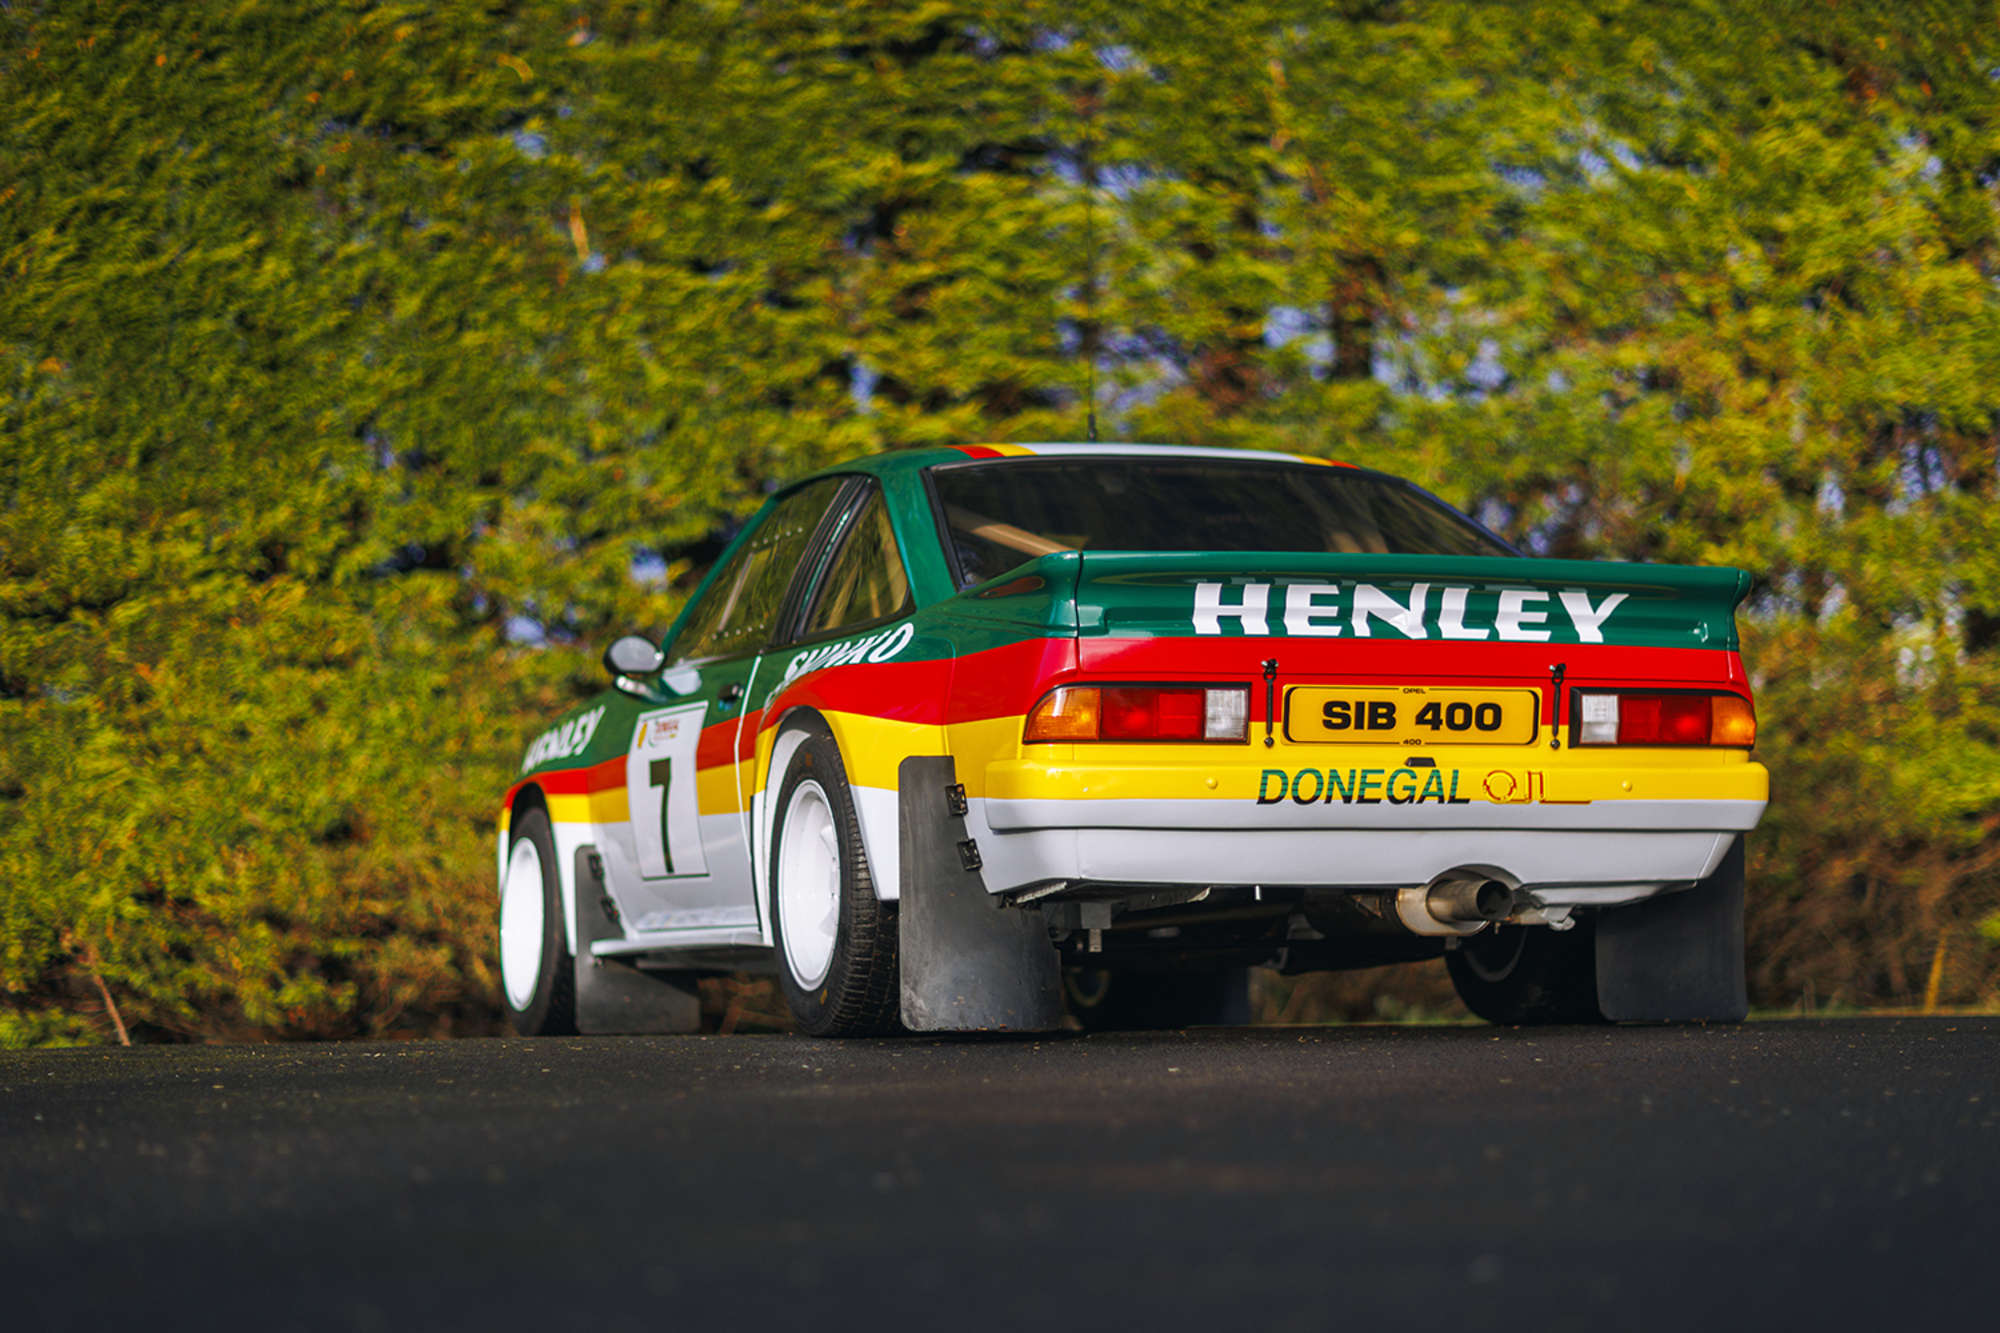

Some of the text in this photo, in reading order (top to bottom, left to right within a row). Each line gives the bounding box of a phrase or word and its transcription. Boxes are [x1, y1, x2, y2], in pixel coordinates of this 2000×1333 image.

[1192, 583, 1629, 643] HENLEY
[1402, 687, 1426, 695] OPEL
[1322, 701, 1502, 731] SIB 400
[1402, 738, 1422, 746] 400
[1256, 768, 1471, 805] DONEGAL
[649, 757, 675, 874] 7
